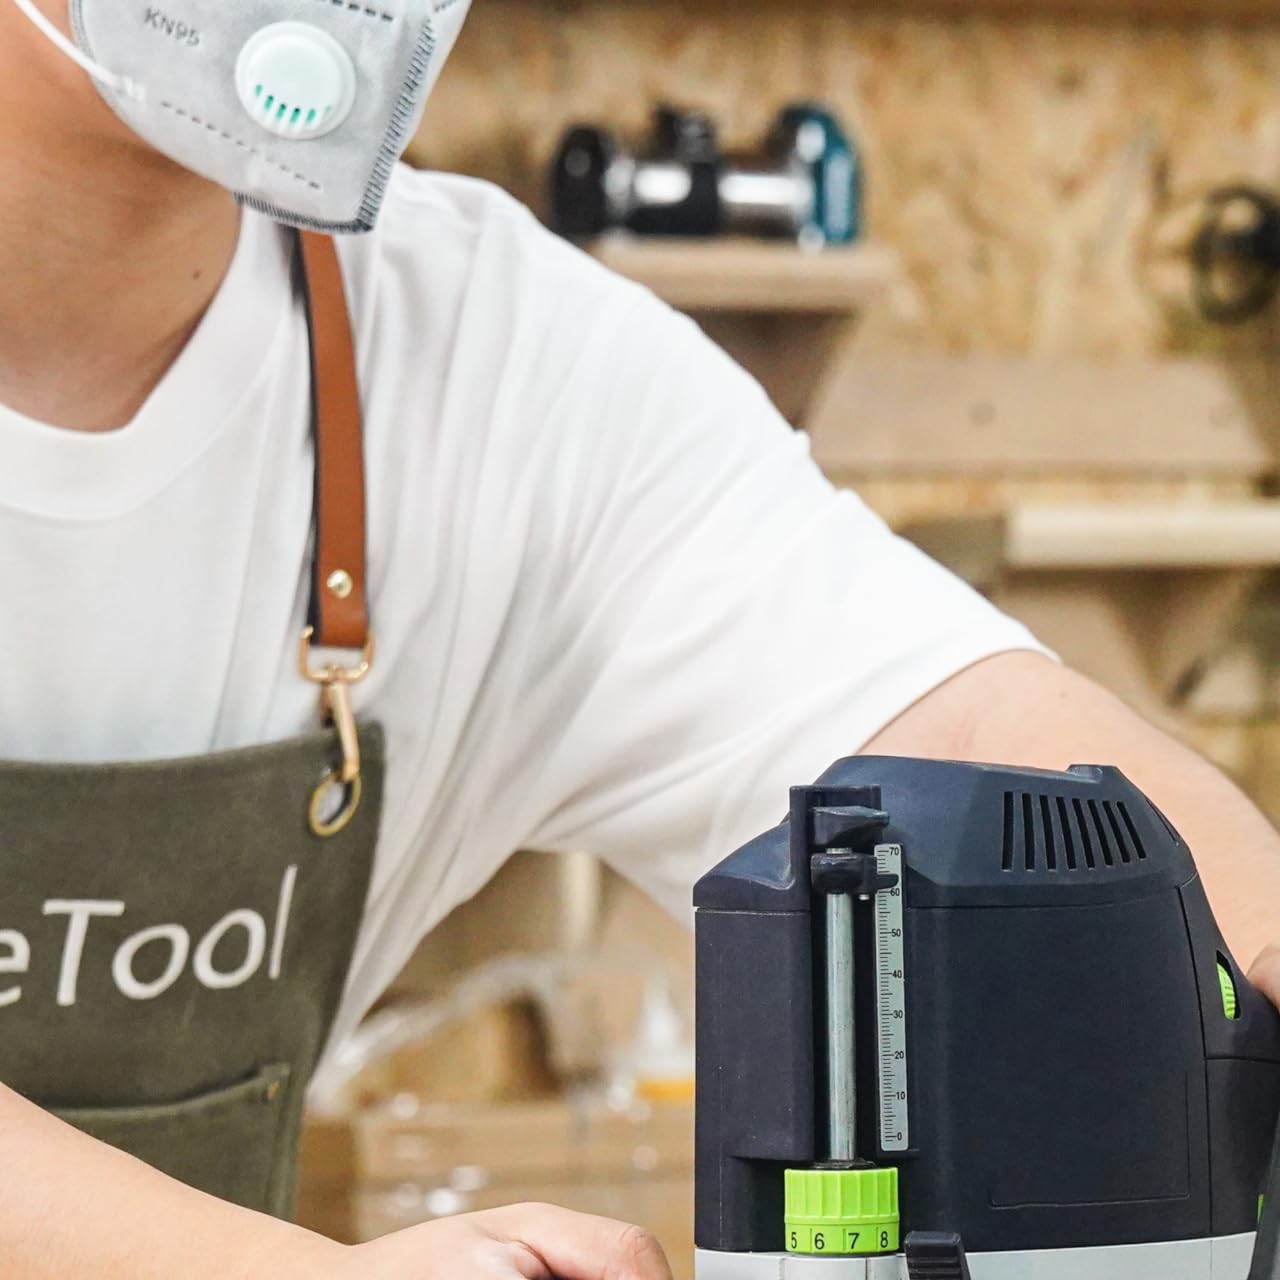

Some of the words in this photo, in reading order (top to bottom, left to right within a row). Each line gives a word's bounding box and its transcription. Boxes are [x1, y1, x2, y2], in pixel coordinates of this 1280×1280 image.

[143, 7, 200, 47] KN95
[888, 847, 899, 856] 70
[890, 887, 900, 897] 60
[891, 928, 901, 938] 50
[892, 969, 903, 979] 40
[893, 1009, 903, 1019] 30
[894, 1050, 904, 1060] 20
[896, 1091, 906, 1101] 10
[897, 1132, 903, 1141] 0
[791, 1231, 798, 1249] 5
[814, 1232, 825, 1250] 6
[848, 1232, 860, 1250] 7
[880, 1230, 889, 1249] 8
